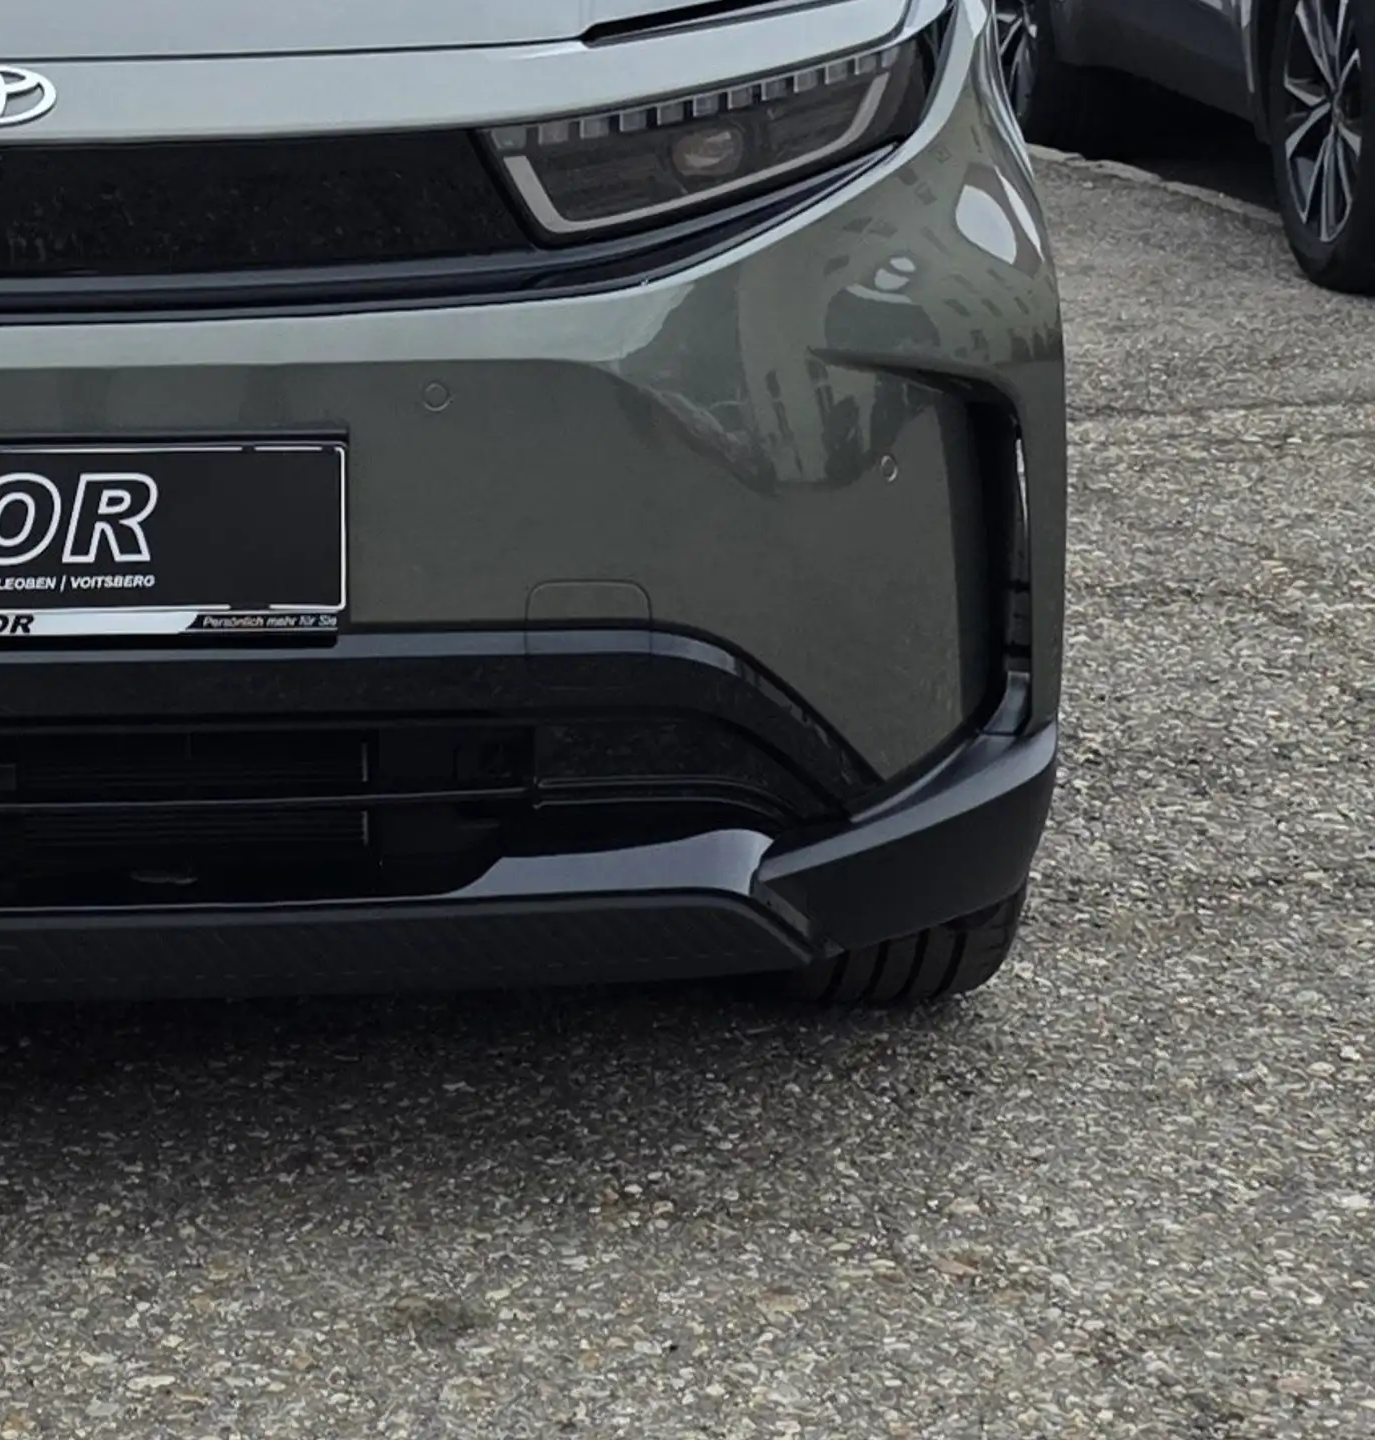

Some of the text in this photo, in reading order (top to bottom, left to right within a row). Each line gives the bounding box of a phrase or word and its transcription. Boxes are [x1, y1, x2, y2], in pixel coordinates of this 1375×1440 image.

[71, 575, 156, 590] VOITSBERG
[202, 615, 264, 628] Persönlich
[318, 614, 337, 626] Sie
